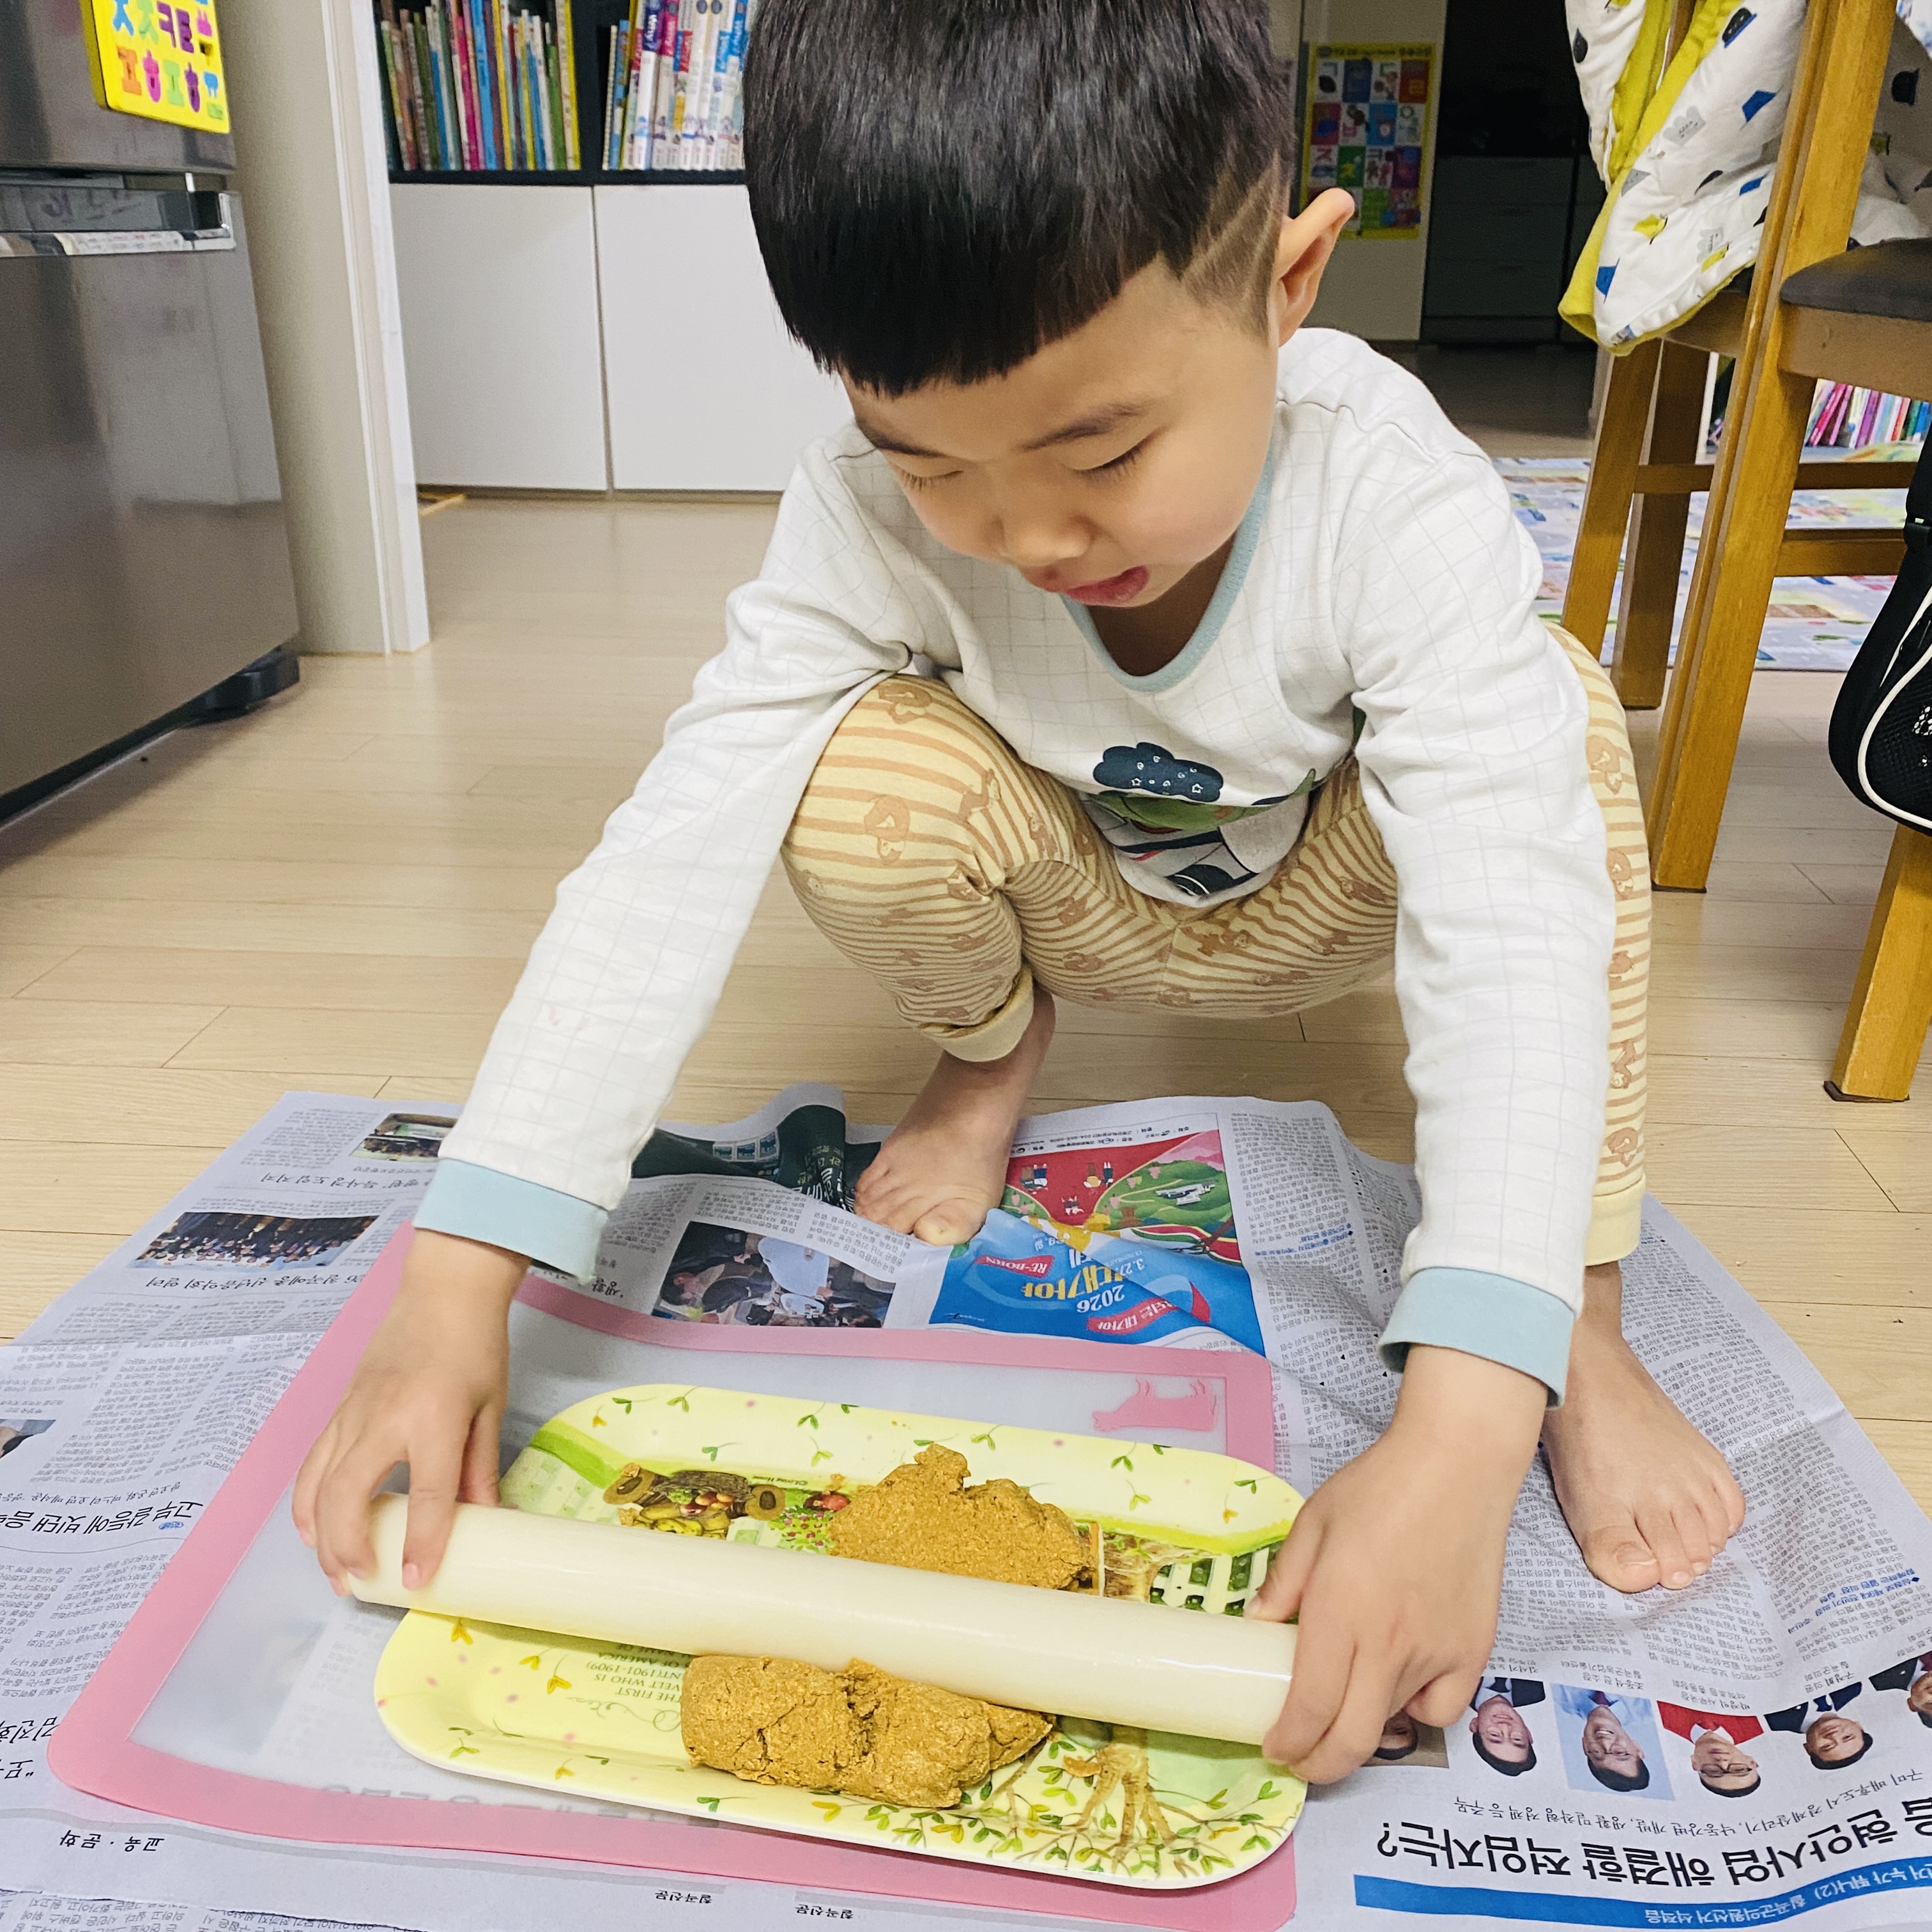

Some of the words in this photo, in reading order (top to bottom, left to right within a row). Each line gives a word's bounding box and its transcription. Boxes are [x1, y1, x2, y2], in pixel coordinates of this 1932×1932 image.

[259, 1172, 291, 1183] 지지
[296, 1175, 330, 1184] 도입
[985, 1255, 1048, 1275] RE-BORN
[145, 1276, 180, 1288] 열려
[182, 1276, 268, 1290] 신년음악회
[273, 1274, 340, 1286] 칠곡예총
[1021, 1264, 1123, 1300] 대가야
[1076, 1284, 1125, 1314] 2026
[1098, 1314, 1138, 1331] 대가야
[31, 1492, 64, 1503] 매서운
[126, 1489, 148, 1501] 온화,
[149, 1485, 171, 1496] 오면
[65, 1495, 86, 1505] 오면
[89, 1495, 121, 1505] 며느리
[151, 1501, 203, 1522] 고부
[0, 1510, 34, 1529] 음
[31, 1514, 86, 1533] 빗댄
[82, 1506, 153, 1534] 갈등에
[1832, 1594, 1859, 1607] 전반기
[1860, 1589, 1883, 1600] 제9대
[1814, 1604, 1831, 1616] 의장
[597, 1652, 658, 1665] AMERICA
[1508, 1664, 1538, 1674] 김석기
[1560, 1660, 1641, 1679] 칠곡군농업기술센터
[1804, 1661, 1849, 1682] 칠곡군의회
[594, 1673, 607, 1682] IS
[610, 1675, 645, 1687] WHO
[1582, 1672, 1600, 1682] 소장
[1600, 1676, 1612, 1685] 전
[1614, 1677, 1644, 1690] 조동석
[614, 1687, 653, 1698] FIRST
[1804, 1678, 1823, 1694] 의원
[658, 1692, 680, 1703] THE
[1890, 1768, 1923, 1786] 구미
[1825, 1779, 1886, 1809] 배후도시
[1453, 1797, 1484, 1816] 주목
[1489, 1803, 1505, 1819] 등
[1509, 1805, 1540, 1821] 정책
[1545, 1807, 1591, 1826] 밀착형
[1596, 1814, 1626, 1830] 생활
[1738, 1804, 1822, 1834] 경제살리기,
[1630, 1818, 1667, 1835] 개발,
[1671, 1821, 1736, 1837] 낙동강변
[59, 1830, 102, 1849] 문화
[124, 1836, 165, 1852] 교육
[1721, 1808, 1897, 1885] 현안사업
[1377, 1821, 1571, 1876] 적임자는?
[1581, 1843, 1715, 1887] 해결할
[1873, 1867, 1907, 1882] 누가
[1814, 1874, 1869, 1900] 뛰나(2)
[29, 1898, 61, 1910] 원고지
[654, 1890, 712, 1905] 칠곡신문
[67, 1901, 112, 1913] 화가이고,
[795, 1904, 854, 1919] 칠곡신문
[1696, 1894, 1805, 1924] 칠곡군의원선거
[20, 1910, 43, 1920] 위에
[49, 1914, 81, 1924] 캔버스
[86, 1916, 117, 1926] 시인은
[124, 1912, 147, 1923] 싶다.
[151, 1912, 185, 1921] 의하고
[1644, 1908, 1693, 1924] 석적읍
